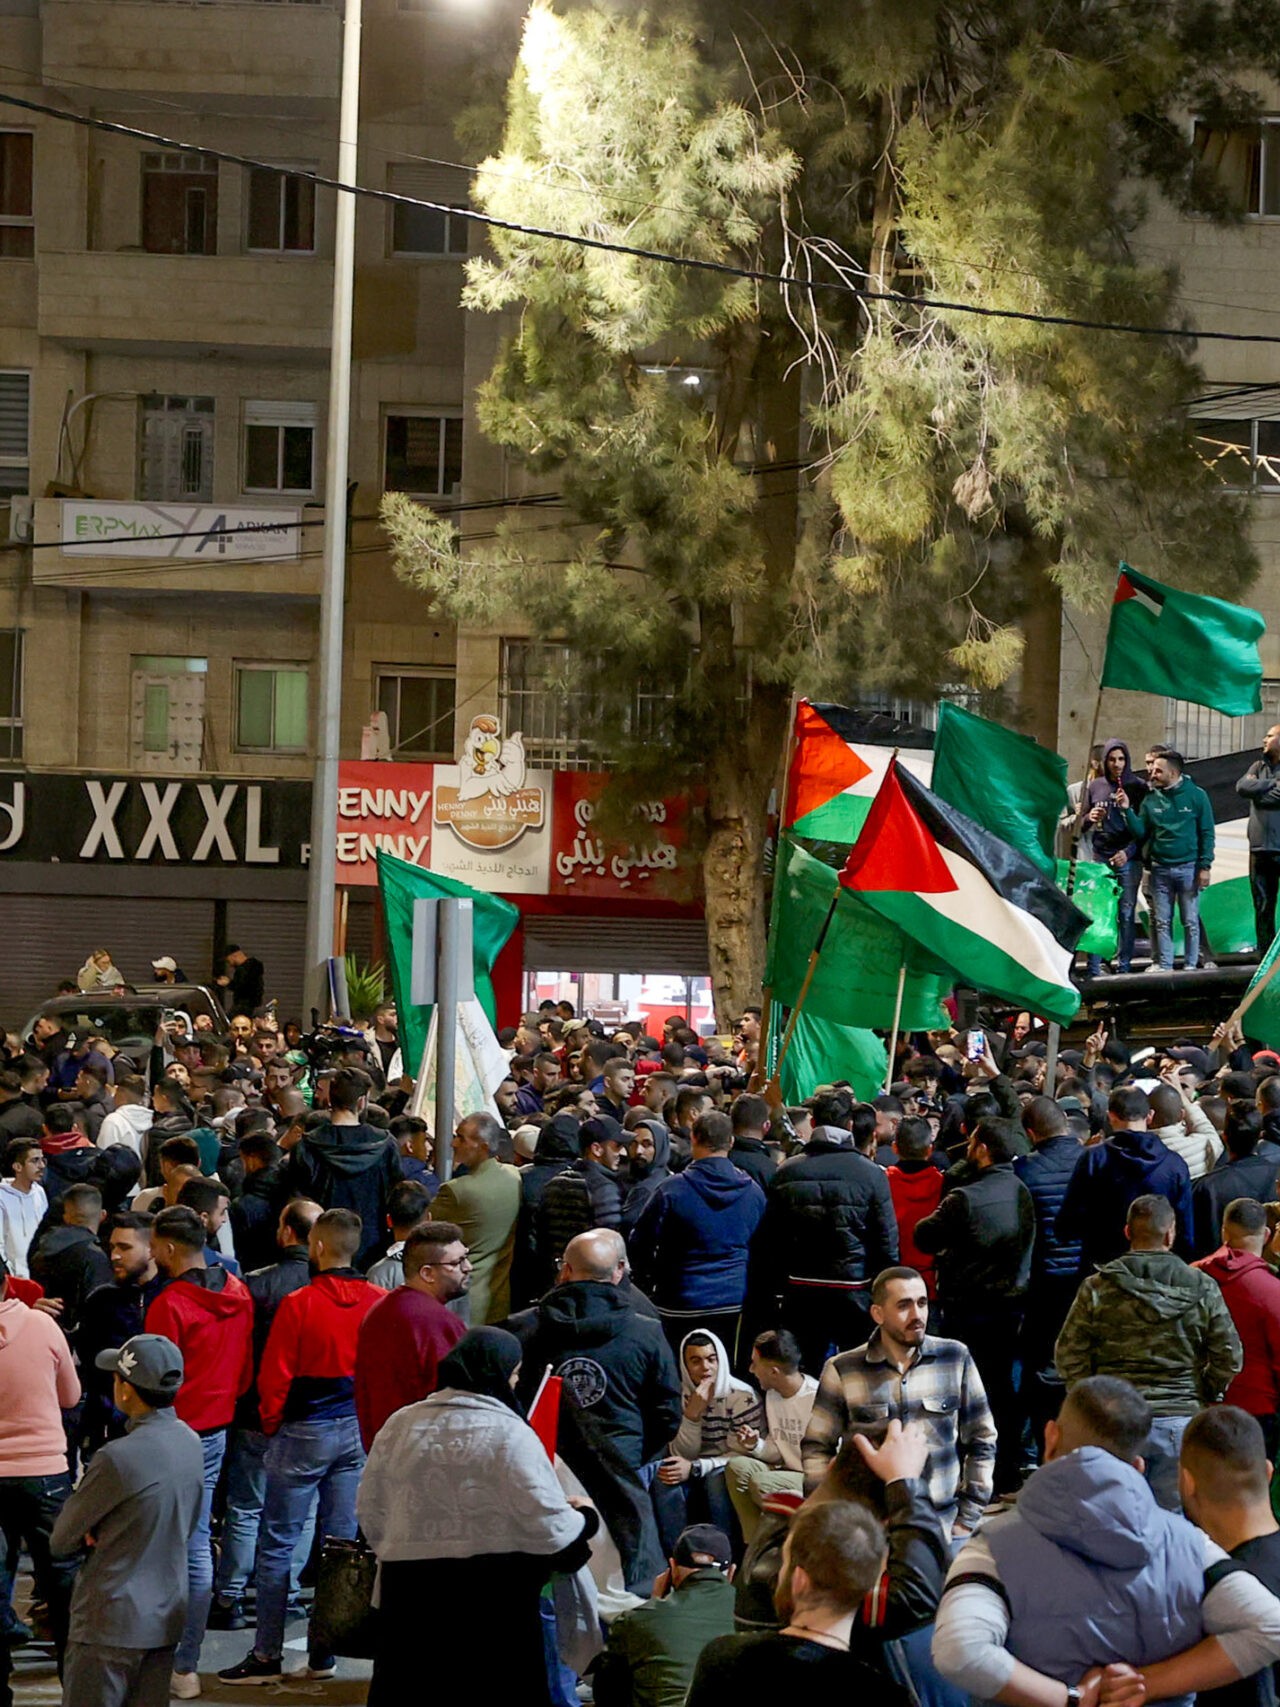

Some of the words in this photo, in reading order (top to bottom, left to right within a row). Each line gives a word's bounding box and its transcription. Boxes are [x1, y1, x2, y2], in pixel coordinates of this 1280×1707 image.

[79, 780, 280, 863] XXXL
[337, 787, 431, 823] ENNY
[336, 832, 430, 865] ENNY
[556, 830, 606, 885] بيني
